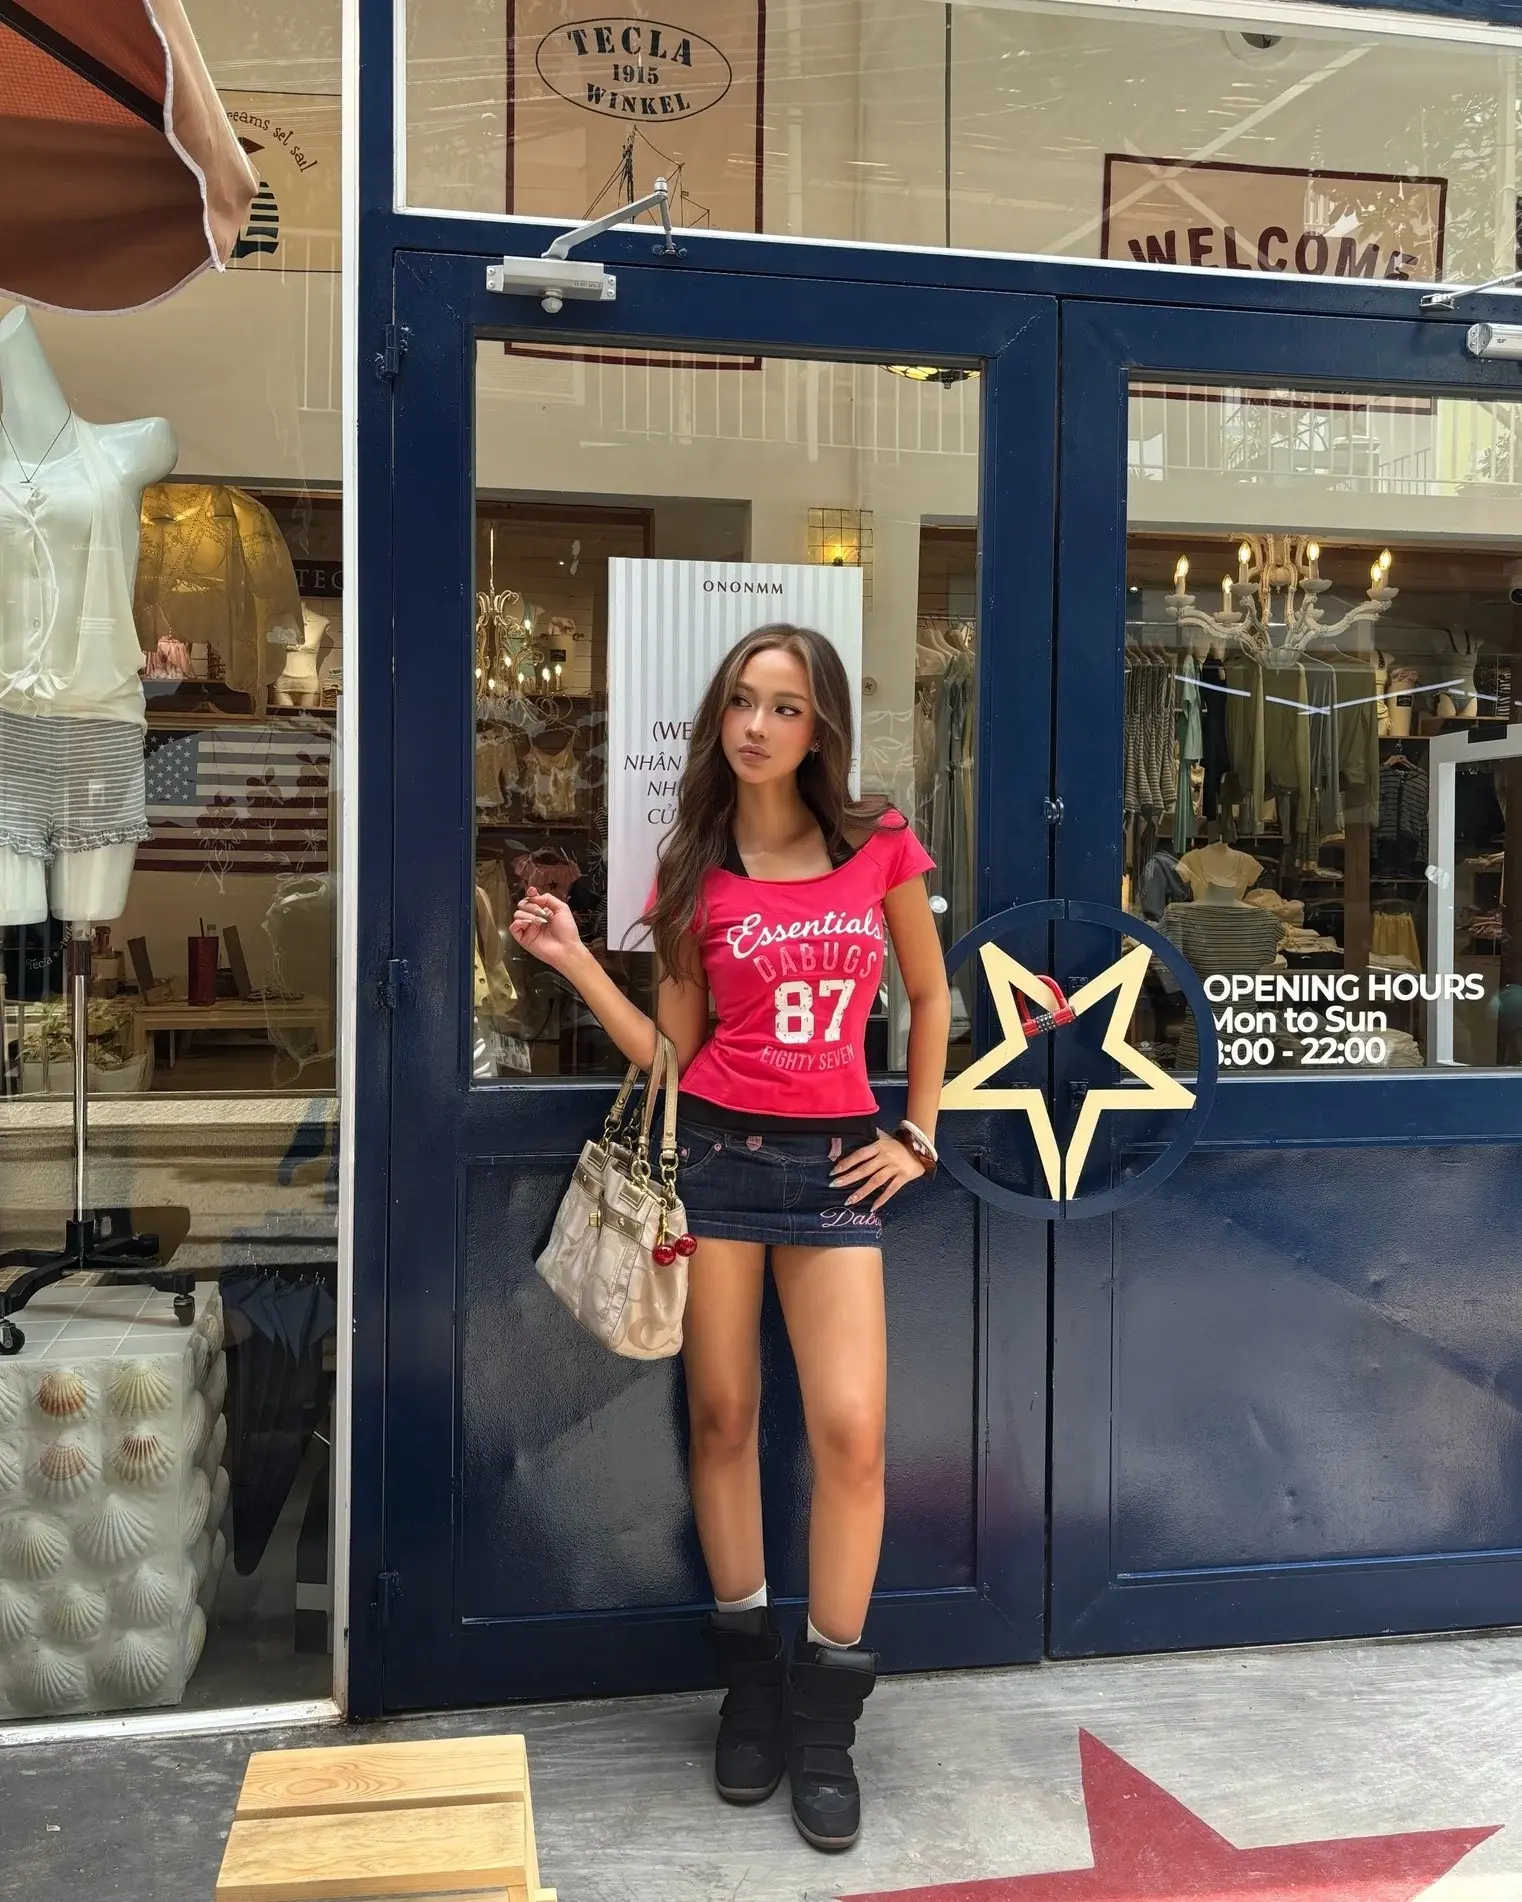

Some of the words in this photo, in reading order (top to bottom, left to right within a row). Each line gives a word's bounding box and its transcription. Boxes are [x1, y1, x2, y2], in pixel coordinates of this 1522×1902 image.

[567, 26, 692, 67] TECLA
[612, 63, 659, 85] 1915
[587, 83, 690, 115] WINKEL
[703, 579, 783, 595] ONONMM
[624, 751, 682, 771] NHÂN
[726, 907, 883, 959] Essentials
[752, 942, 877, 984] DABUGS
[1203, 974, 1360, 1002] OPENING
[1368, 973, 1485, 1001] HOURS
[774, 978, 856, 1044] 87
[1212, 1006, 1277, 1034] Mon
[1283, 1008, 1319, 1033] to
[1325, 1005, 1388, 1033] Sun
[759, 1045, 816, 1071] EIGHTY
[818, 1042, 856, 1071] SEVEN
[1300, 1037, 1387, 1065] 22:00
